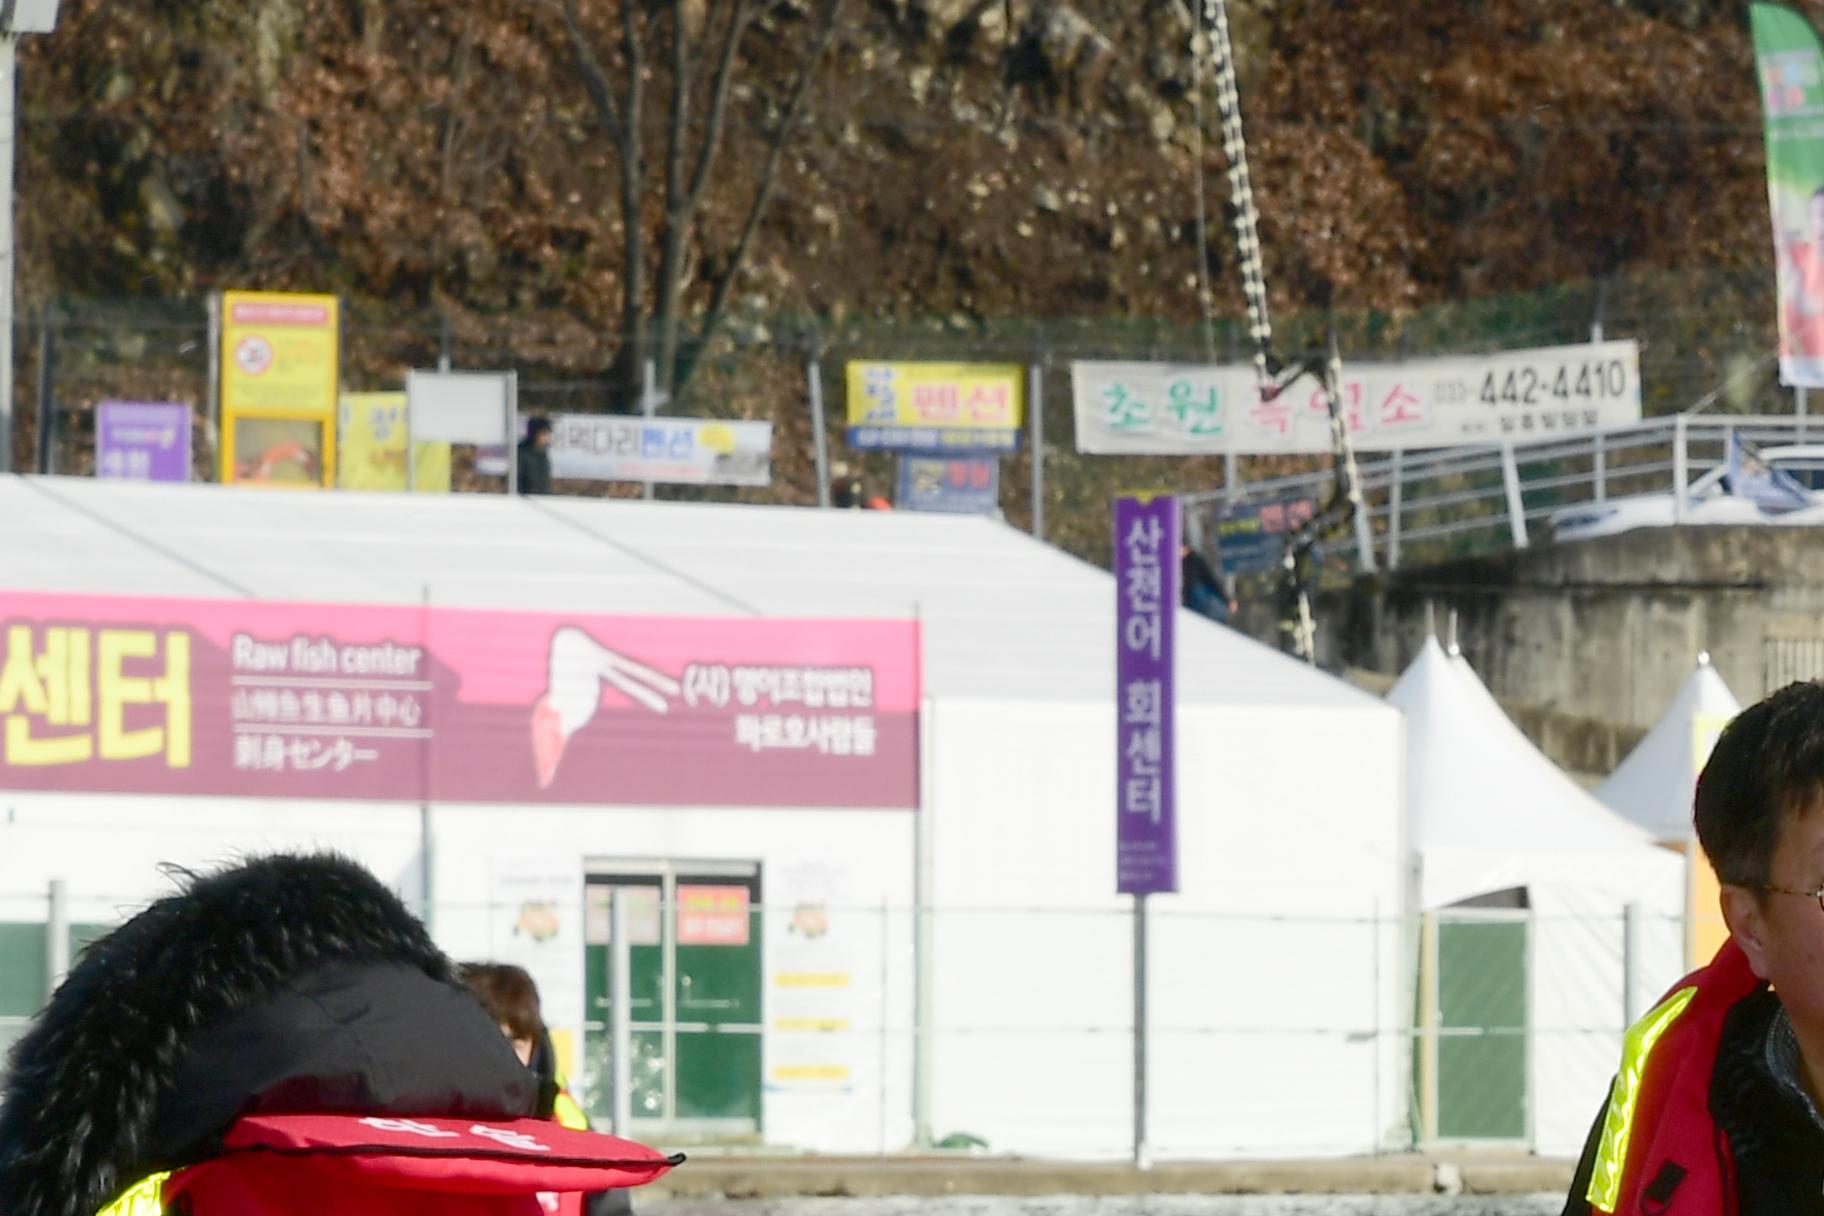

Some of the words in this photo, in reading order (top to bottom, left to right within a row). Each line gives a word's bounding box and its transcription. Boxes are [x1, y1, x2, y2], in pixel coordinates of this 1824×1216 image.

[1103, 379, 1223, 434] 초원
[232, 633, 289, 672] Raw
[291, 634, 338, 673] fish
[340, 643, 422, 675] center
[1124, 514, 1164, 661] 산천어
[0, 622, 191, 769] 센터
[1125, 678, 1163, 825] 회센터
